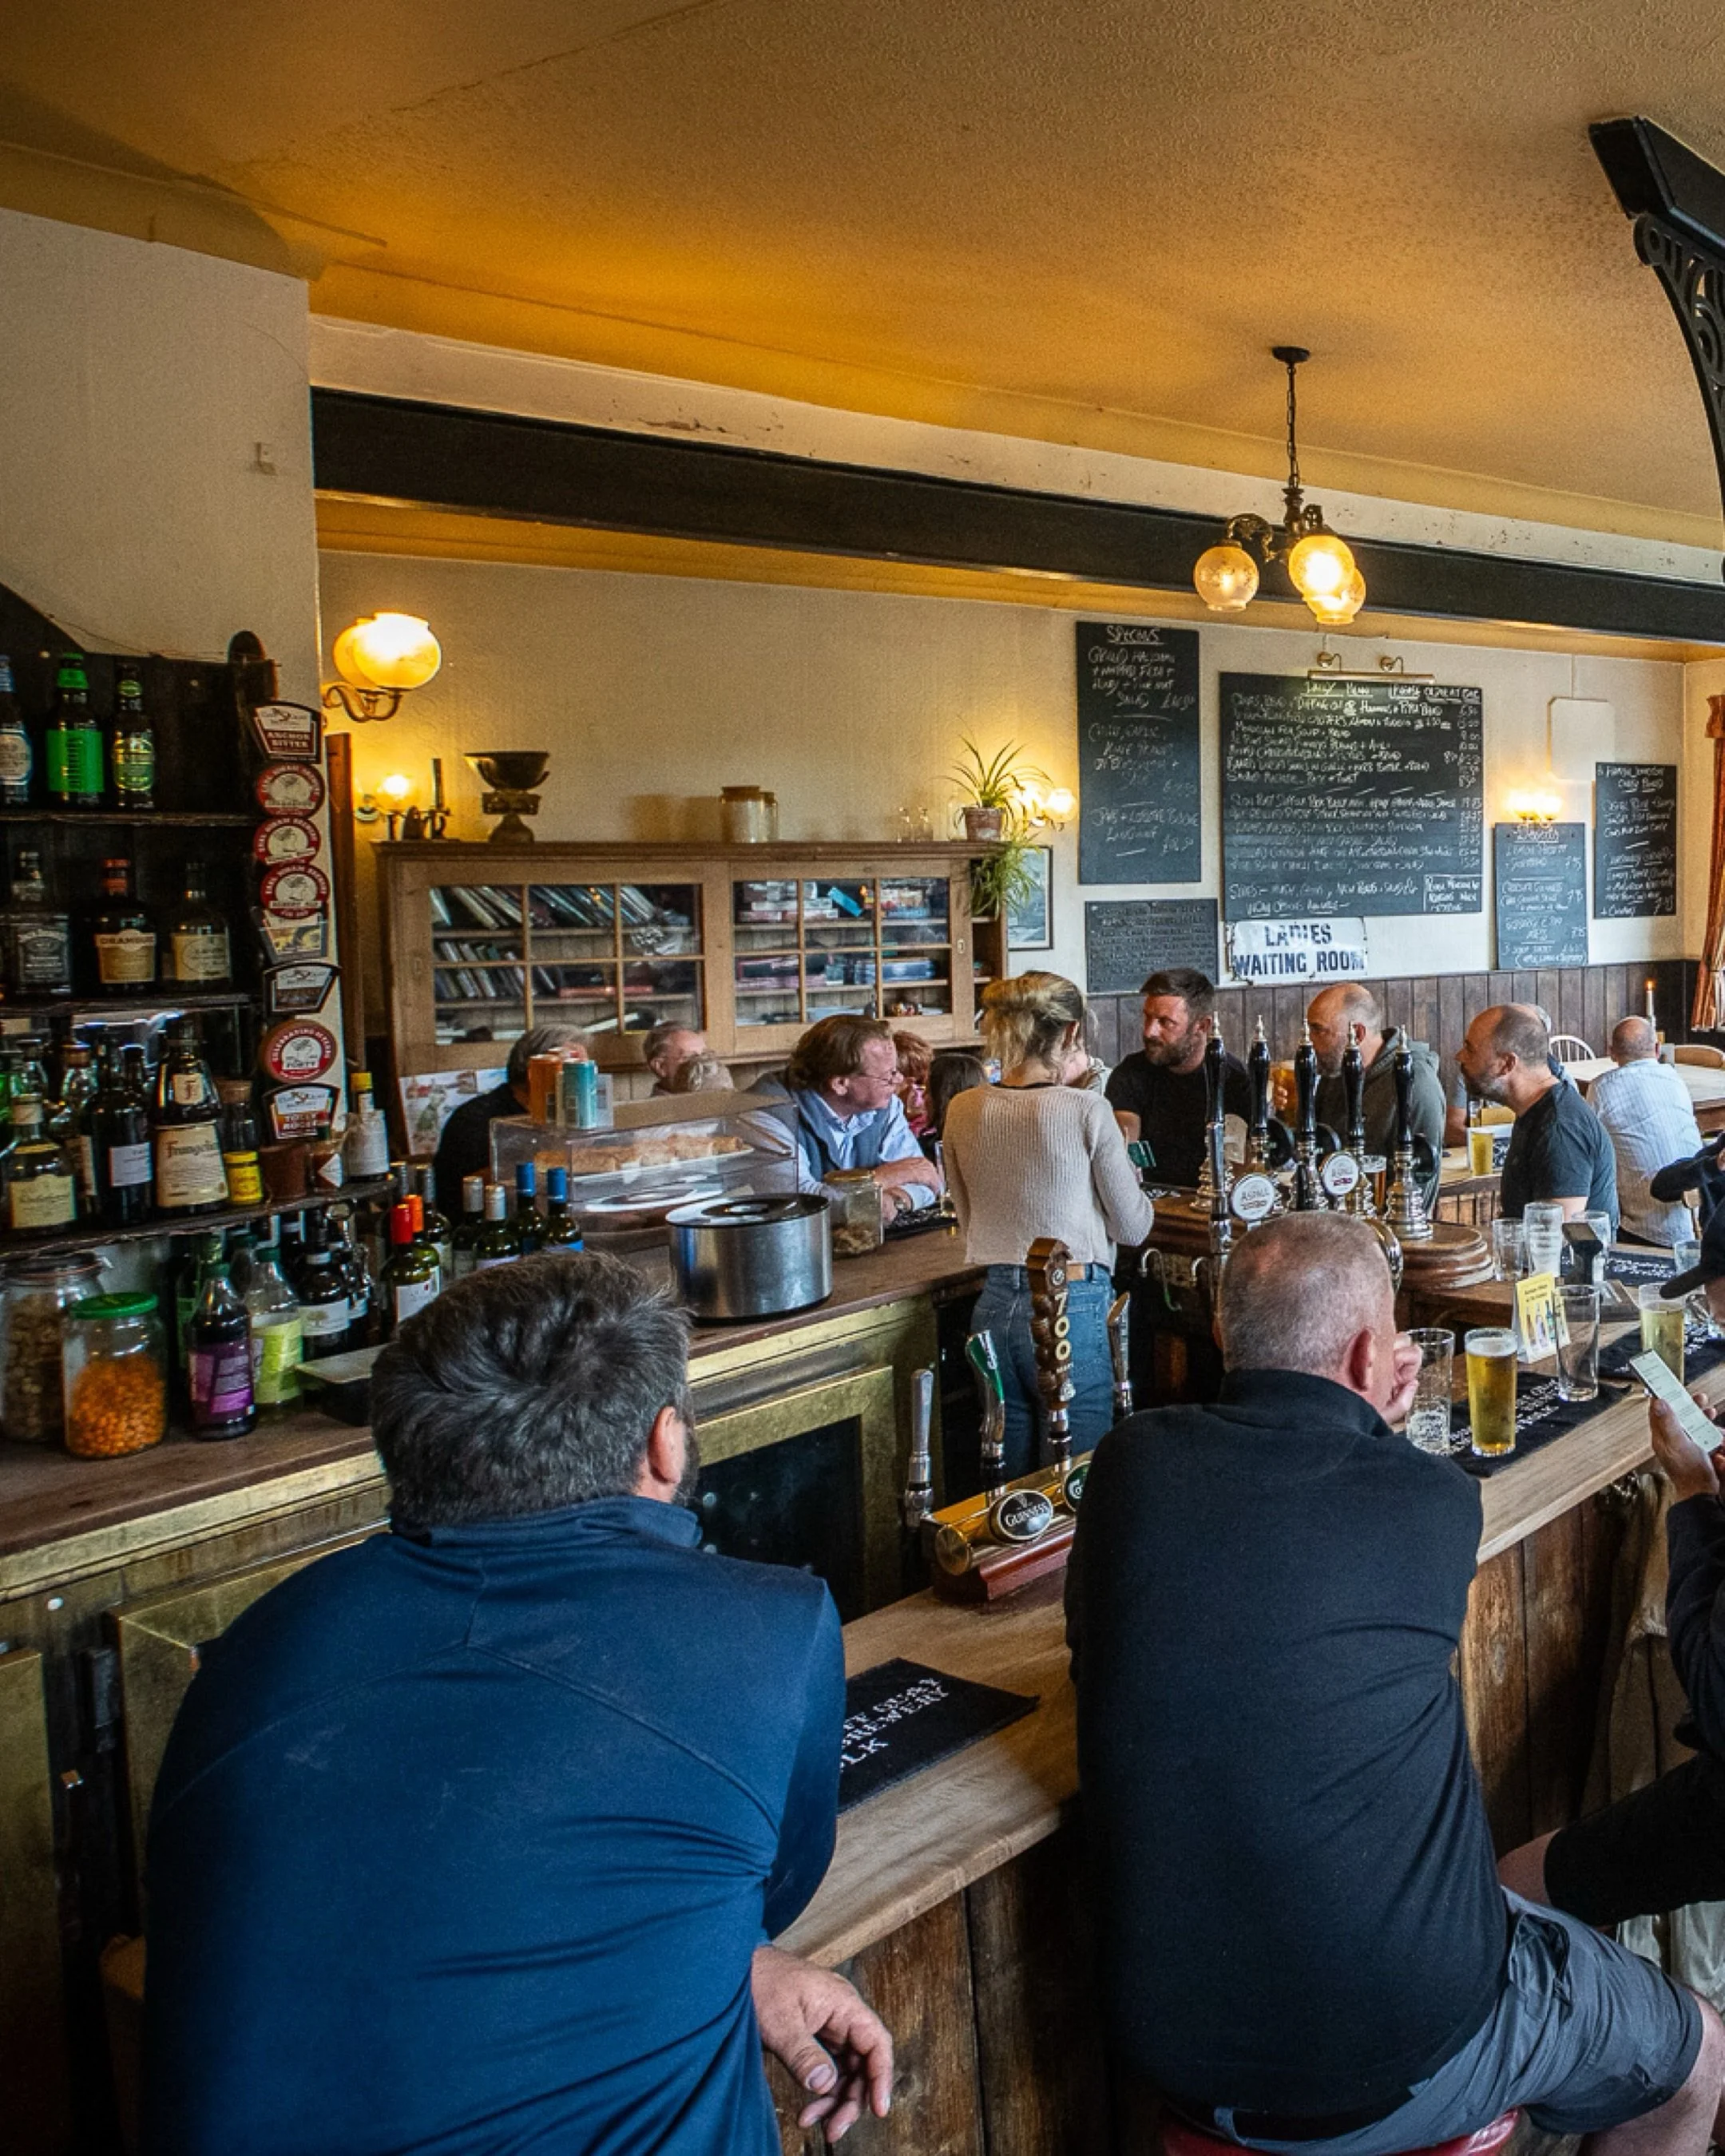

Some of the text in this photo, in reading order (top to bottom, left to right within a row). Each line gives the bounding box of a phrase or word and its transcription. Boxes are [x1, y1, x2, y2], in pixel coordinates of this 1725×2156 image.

[1264, 923, 1332, 946] LADIES
[1234, 950, 1364, 976] WAITING ROOM
[1005, 1501, 1050, 1528] GUINNESS
